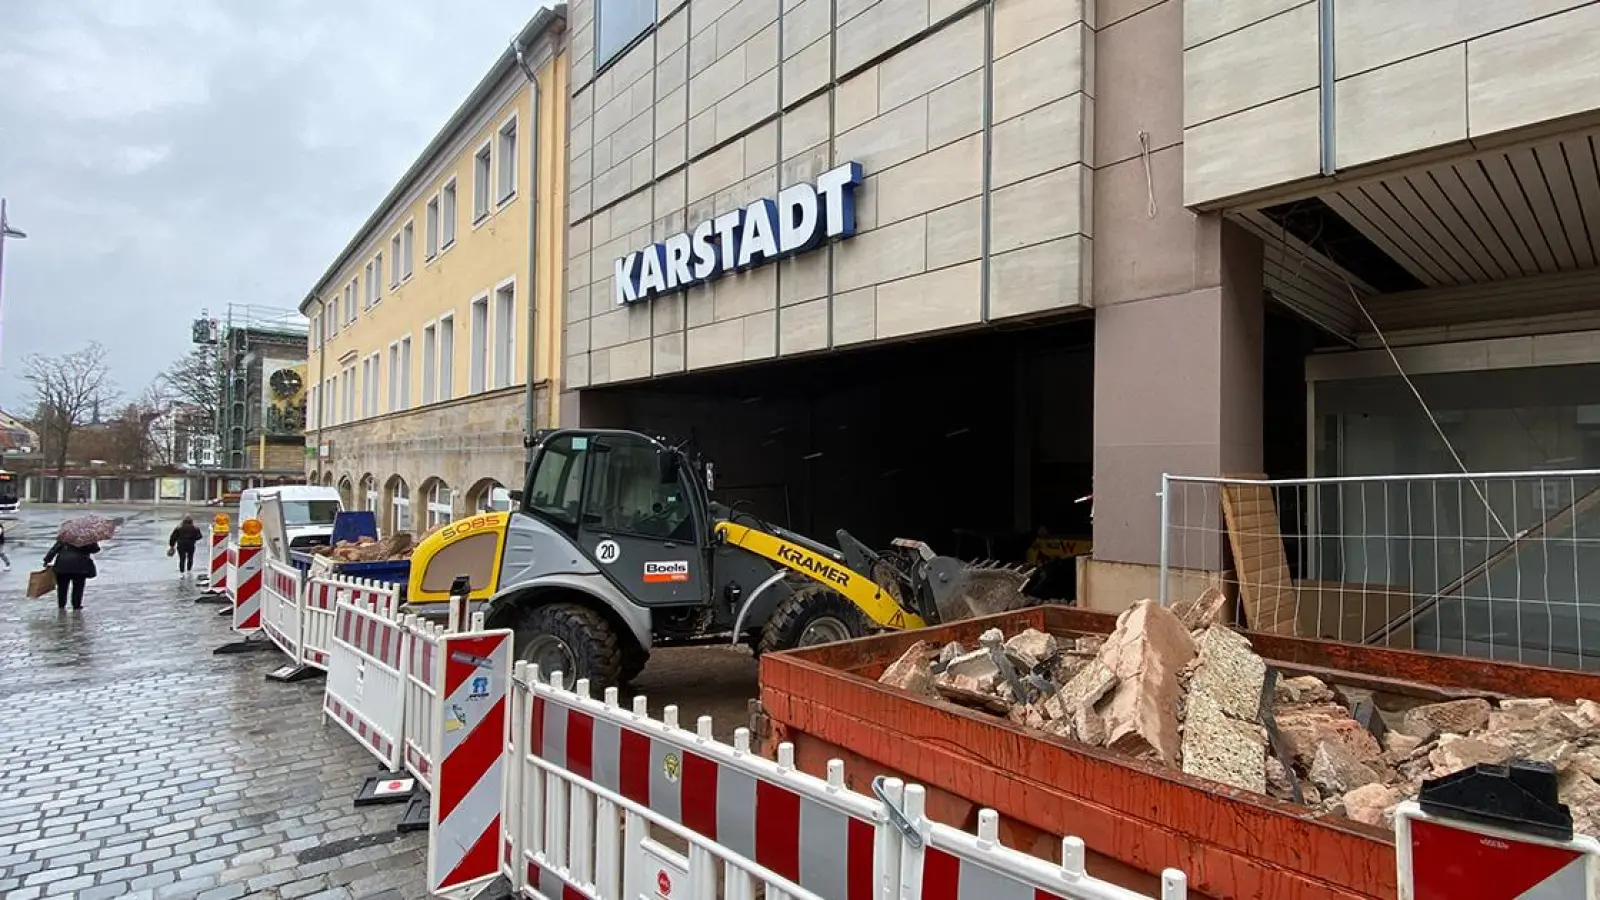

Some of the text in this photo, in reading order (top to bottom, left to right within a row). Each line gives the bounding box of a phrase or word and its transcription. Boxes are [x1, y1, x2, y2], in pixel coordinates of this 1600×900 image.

[614, 160, 860, 306] KARSTADT
[442, 515, 501, 541] 5085
[600, 543, 616, 560] 20
[645, 562, 687, 574] Boels
[776, 544, 852, 588] KRAMER
